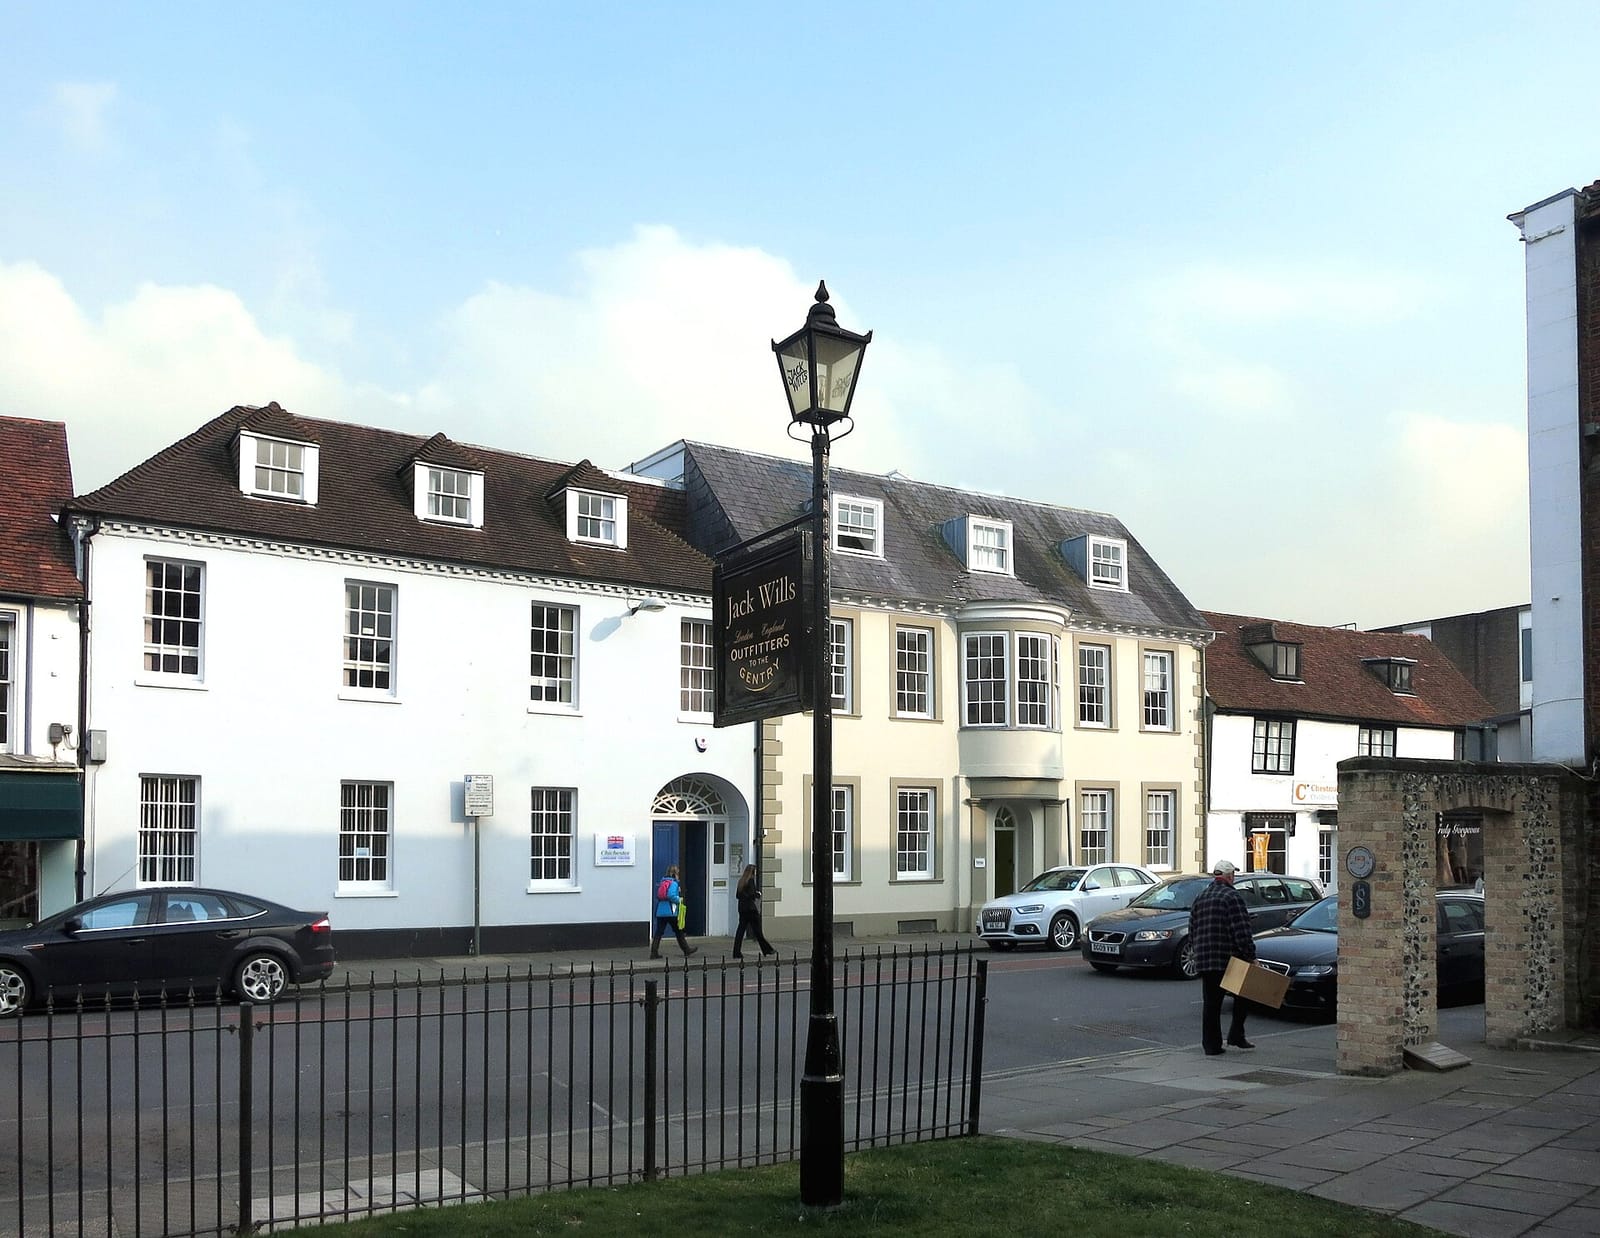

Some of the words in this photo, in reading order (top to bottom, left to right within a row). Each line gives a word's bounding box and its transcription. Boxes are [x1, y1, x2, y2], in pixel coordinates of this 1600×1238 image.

[787, 361, 805, 385] JACK
[791, 370, 808, 392] WILLS
[725, 588, 755, 630] Jack
[758, 575, 796, 609] Wills
[761, 618, 786, 638] England
[730, 633, 790, 661] OUTFITTERS
[739, 657, 779, 685] GENTRY
[749, 659, 757, 667] TO
[757, 655, 769, 665] THE
[1310, 784, 1337, 792] Chestnu
[1437, 824, 1451, 838] ruly
